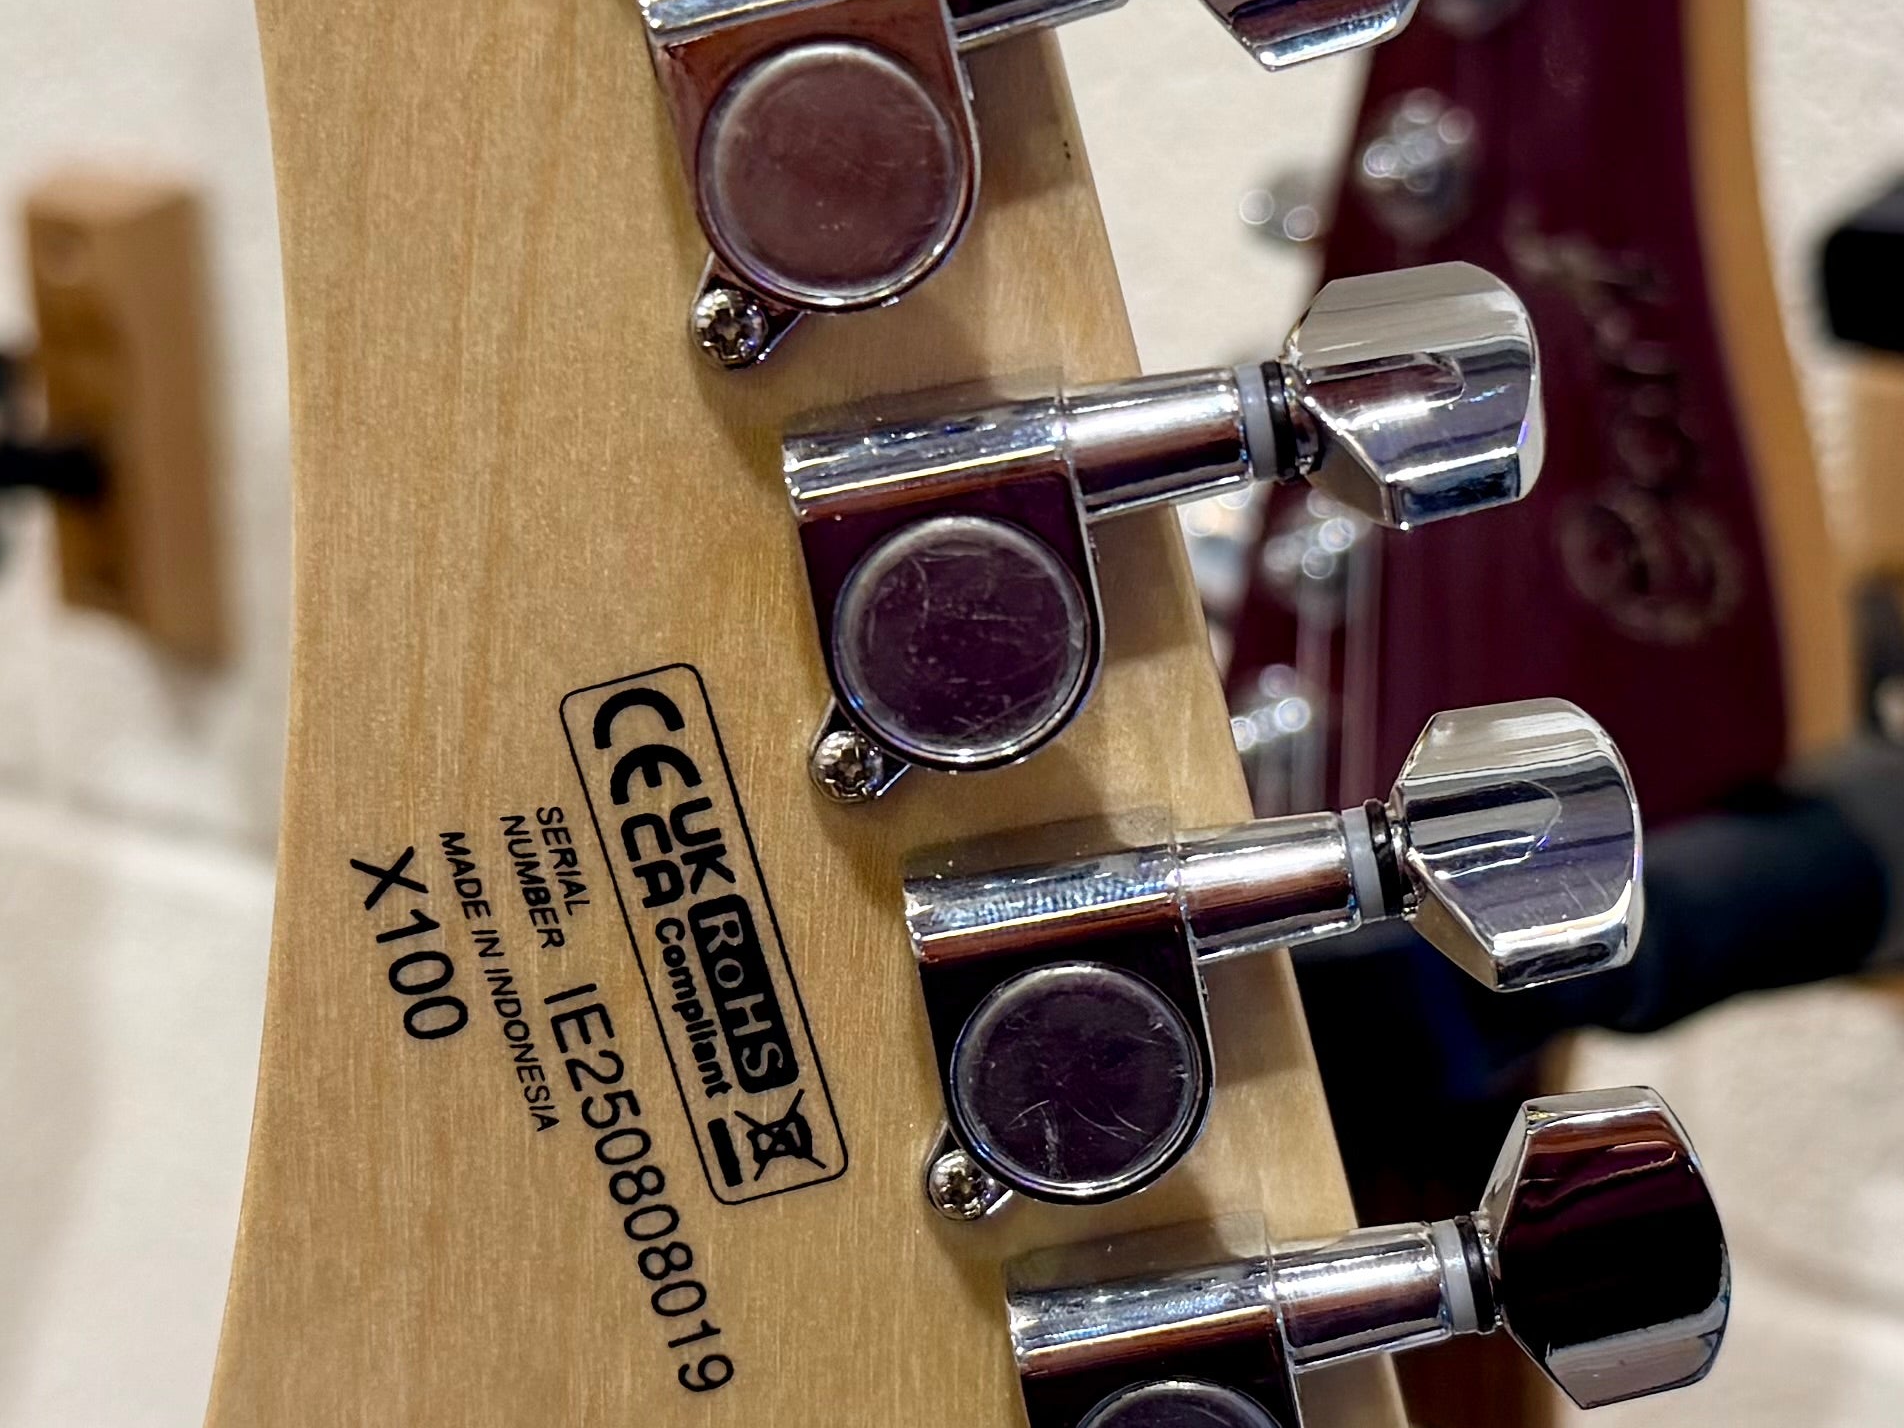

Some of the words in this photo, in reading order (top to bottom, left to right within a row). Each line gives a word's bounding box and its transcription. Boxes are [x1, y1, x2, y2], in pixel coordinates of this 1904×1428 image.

[592, 686, 704, 806] CE
[438, 831, 492, 921] MADE
[499, 814, 566, 950] NUMBER
[535, 806, 591, 917] SERIAL
[619, 812, 687, 910] CA
[668, 795, 737, 896] UK
[349, 845, 469, 1042] X100
[470, 929, 506, 958] IN
[698, 908, 785, 1080] RoHS
[483, 967, 560, 1133] INDONESIA
[654, 916, 734, 1100] Compliant
[543, 982, 736, 1394] IE250808019
